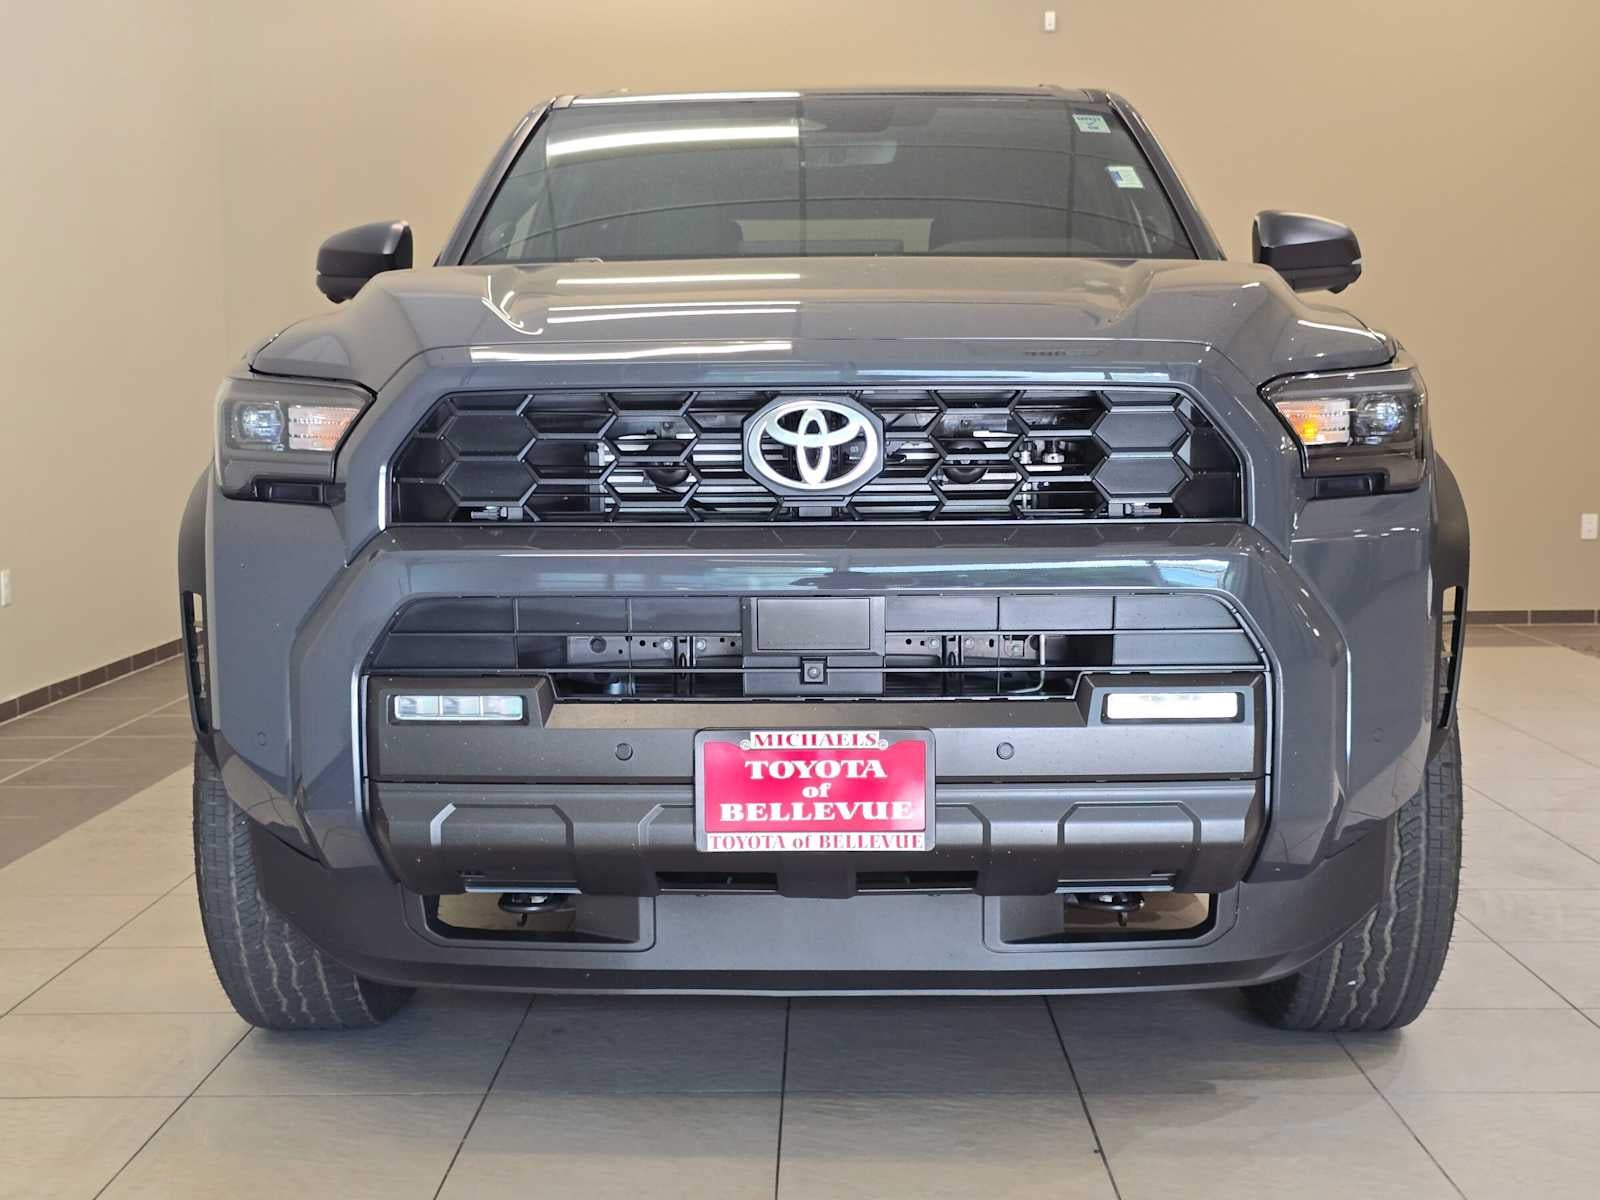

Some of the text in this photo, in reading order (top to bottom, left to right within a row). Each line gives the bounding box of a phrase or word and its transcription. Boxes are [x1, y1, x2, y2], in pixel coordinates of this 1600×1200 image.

[752, 733, 878, 747] MICHAELS
[744, 759, 888, 780] TOYOTA
[801, 782, 832, 798] of
[719, 801, 914, 822] BELLEVUE
[709, 834, 924, 850] TOYOTA of BELLEVUE
